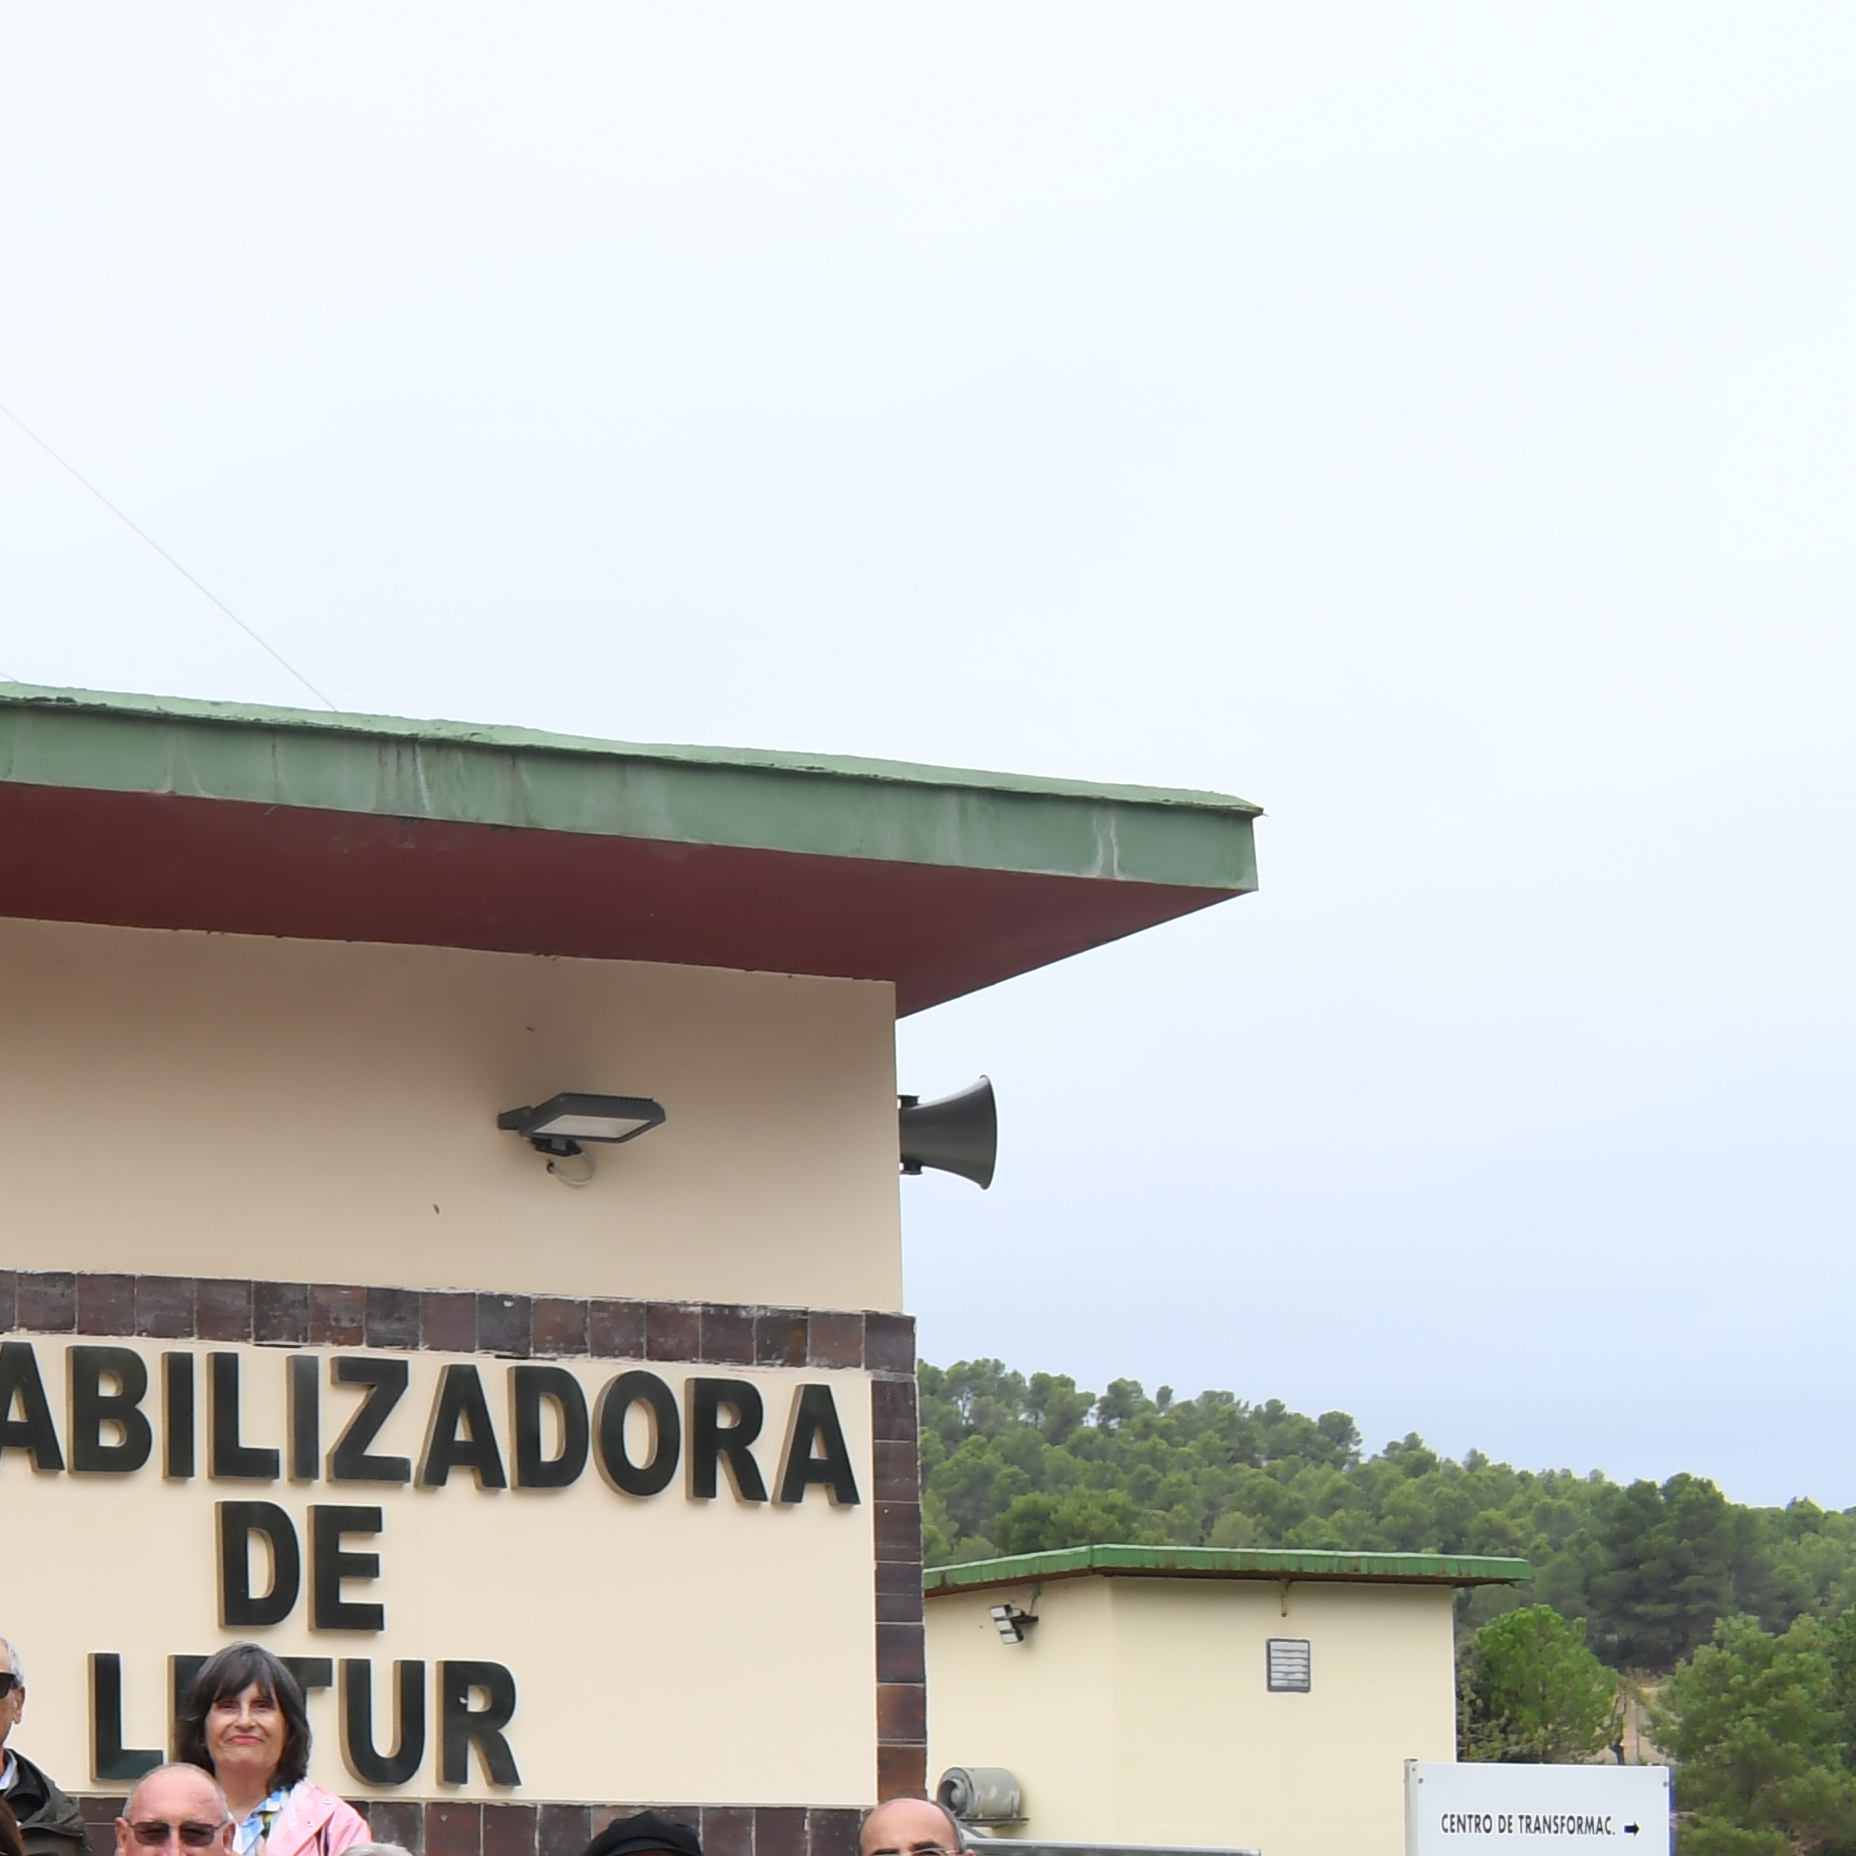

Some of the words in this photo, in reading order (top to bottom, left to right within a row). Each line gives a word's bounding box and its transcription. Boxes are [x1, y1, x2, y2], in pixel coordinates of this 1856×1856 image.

[216, 1500, 385, 1633] DE
[1441, 1813, 1493, 1835] CENTRO
[1498, 1814, 1514, 1834] DE
[1518, 1814, 1616, 1837] TRANSFORMAC.
